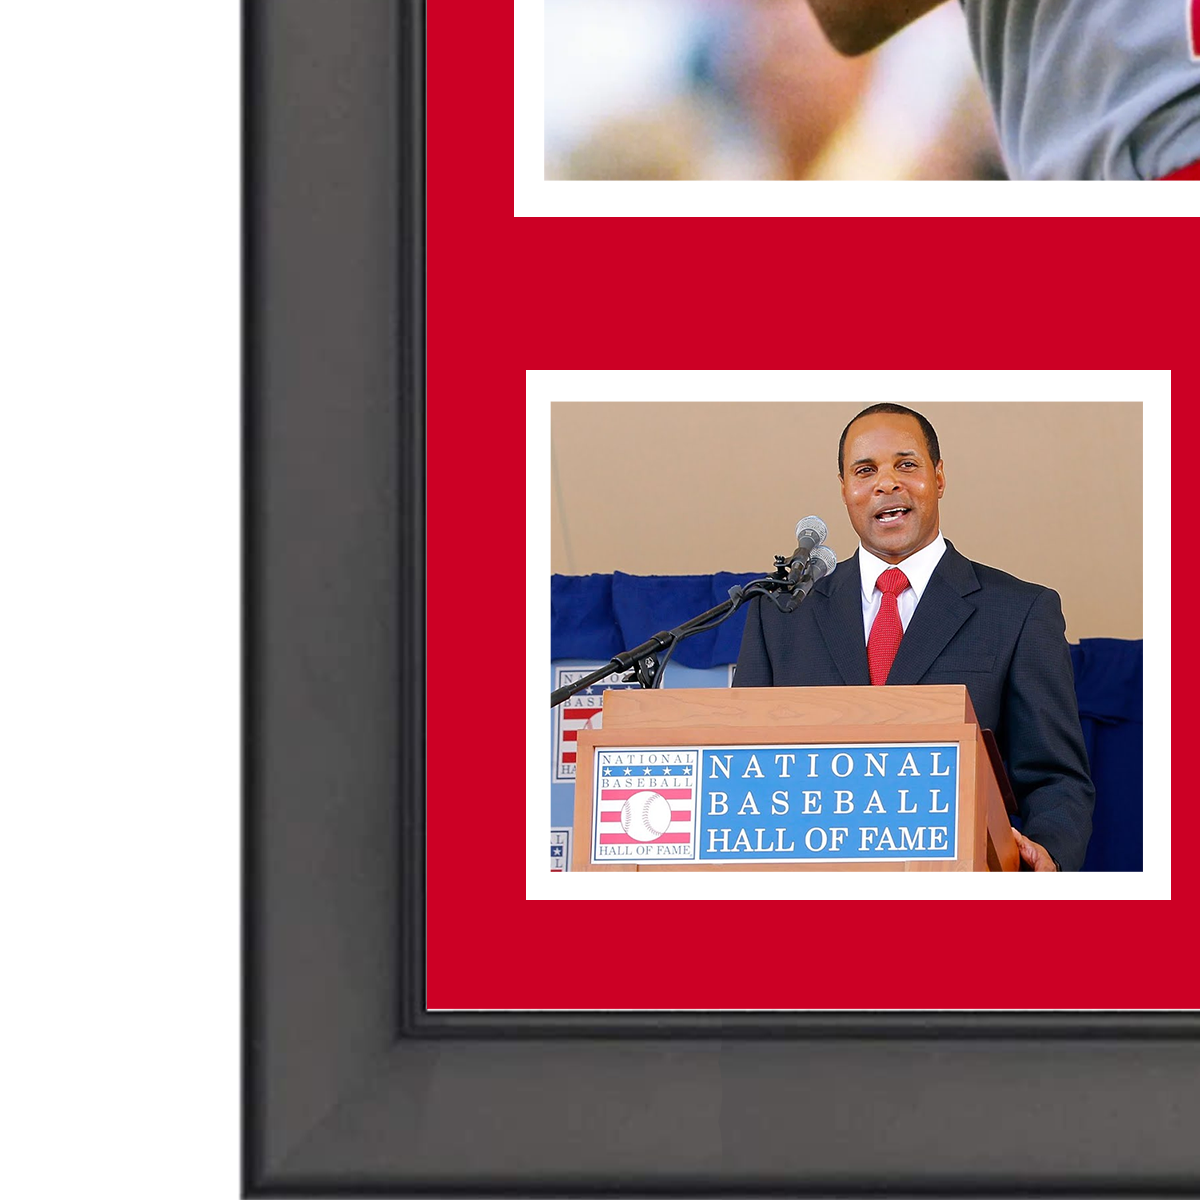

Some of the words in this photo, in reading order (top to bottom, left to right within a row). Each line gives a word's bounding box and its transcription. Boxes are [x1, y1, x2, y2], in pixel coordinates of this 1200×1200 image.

[602, 753, 694, 765] NATIONAL
[708, 752, 951, 779] NATIONAL
[601, 777, 693, 788] BASEBALL
[707, 789, 950, 816] BASEBALL
[706, 828, 795, 853] HALL
[804, 827, 849, 853] OF
[858, 826, 949, 852] FAME
[599, 845, 633, 856] HALL
[636, 845, 653, 855] OF
[656, 844, 691, 855] FAME
